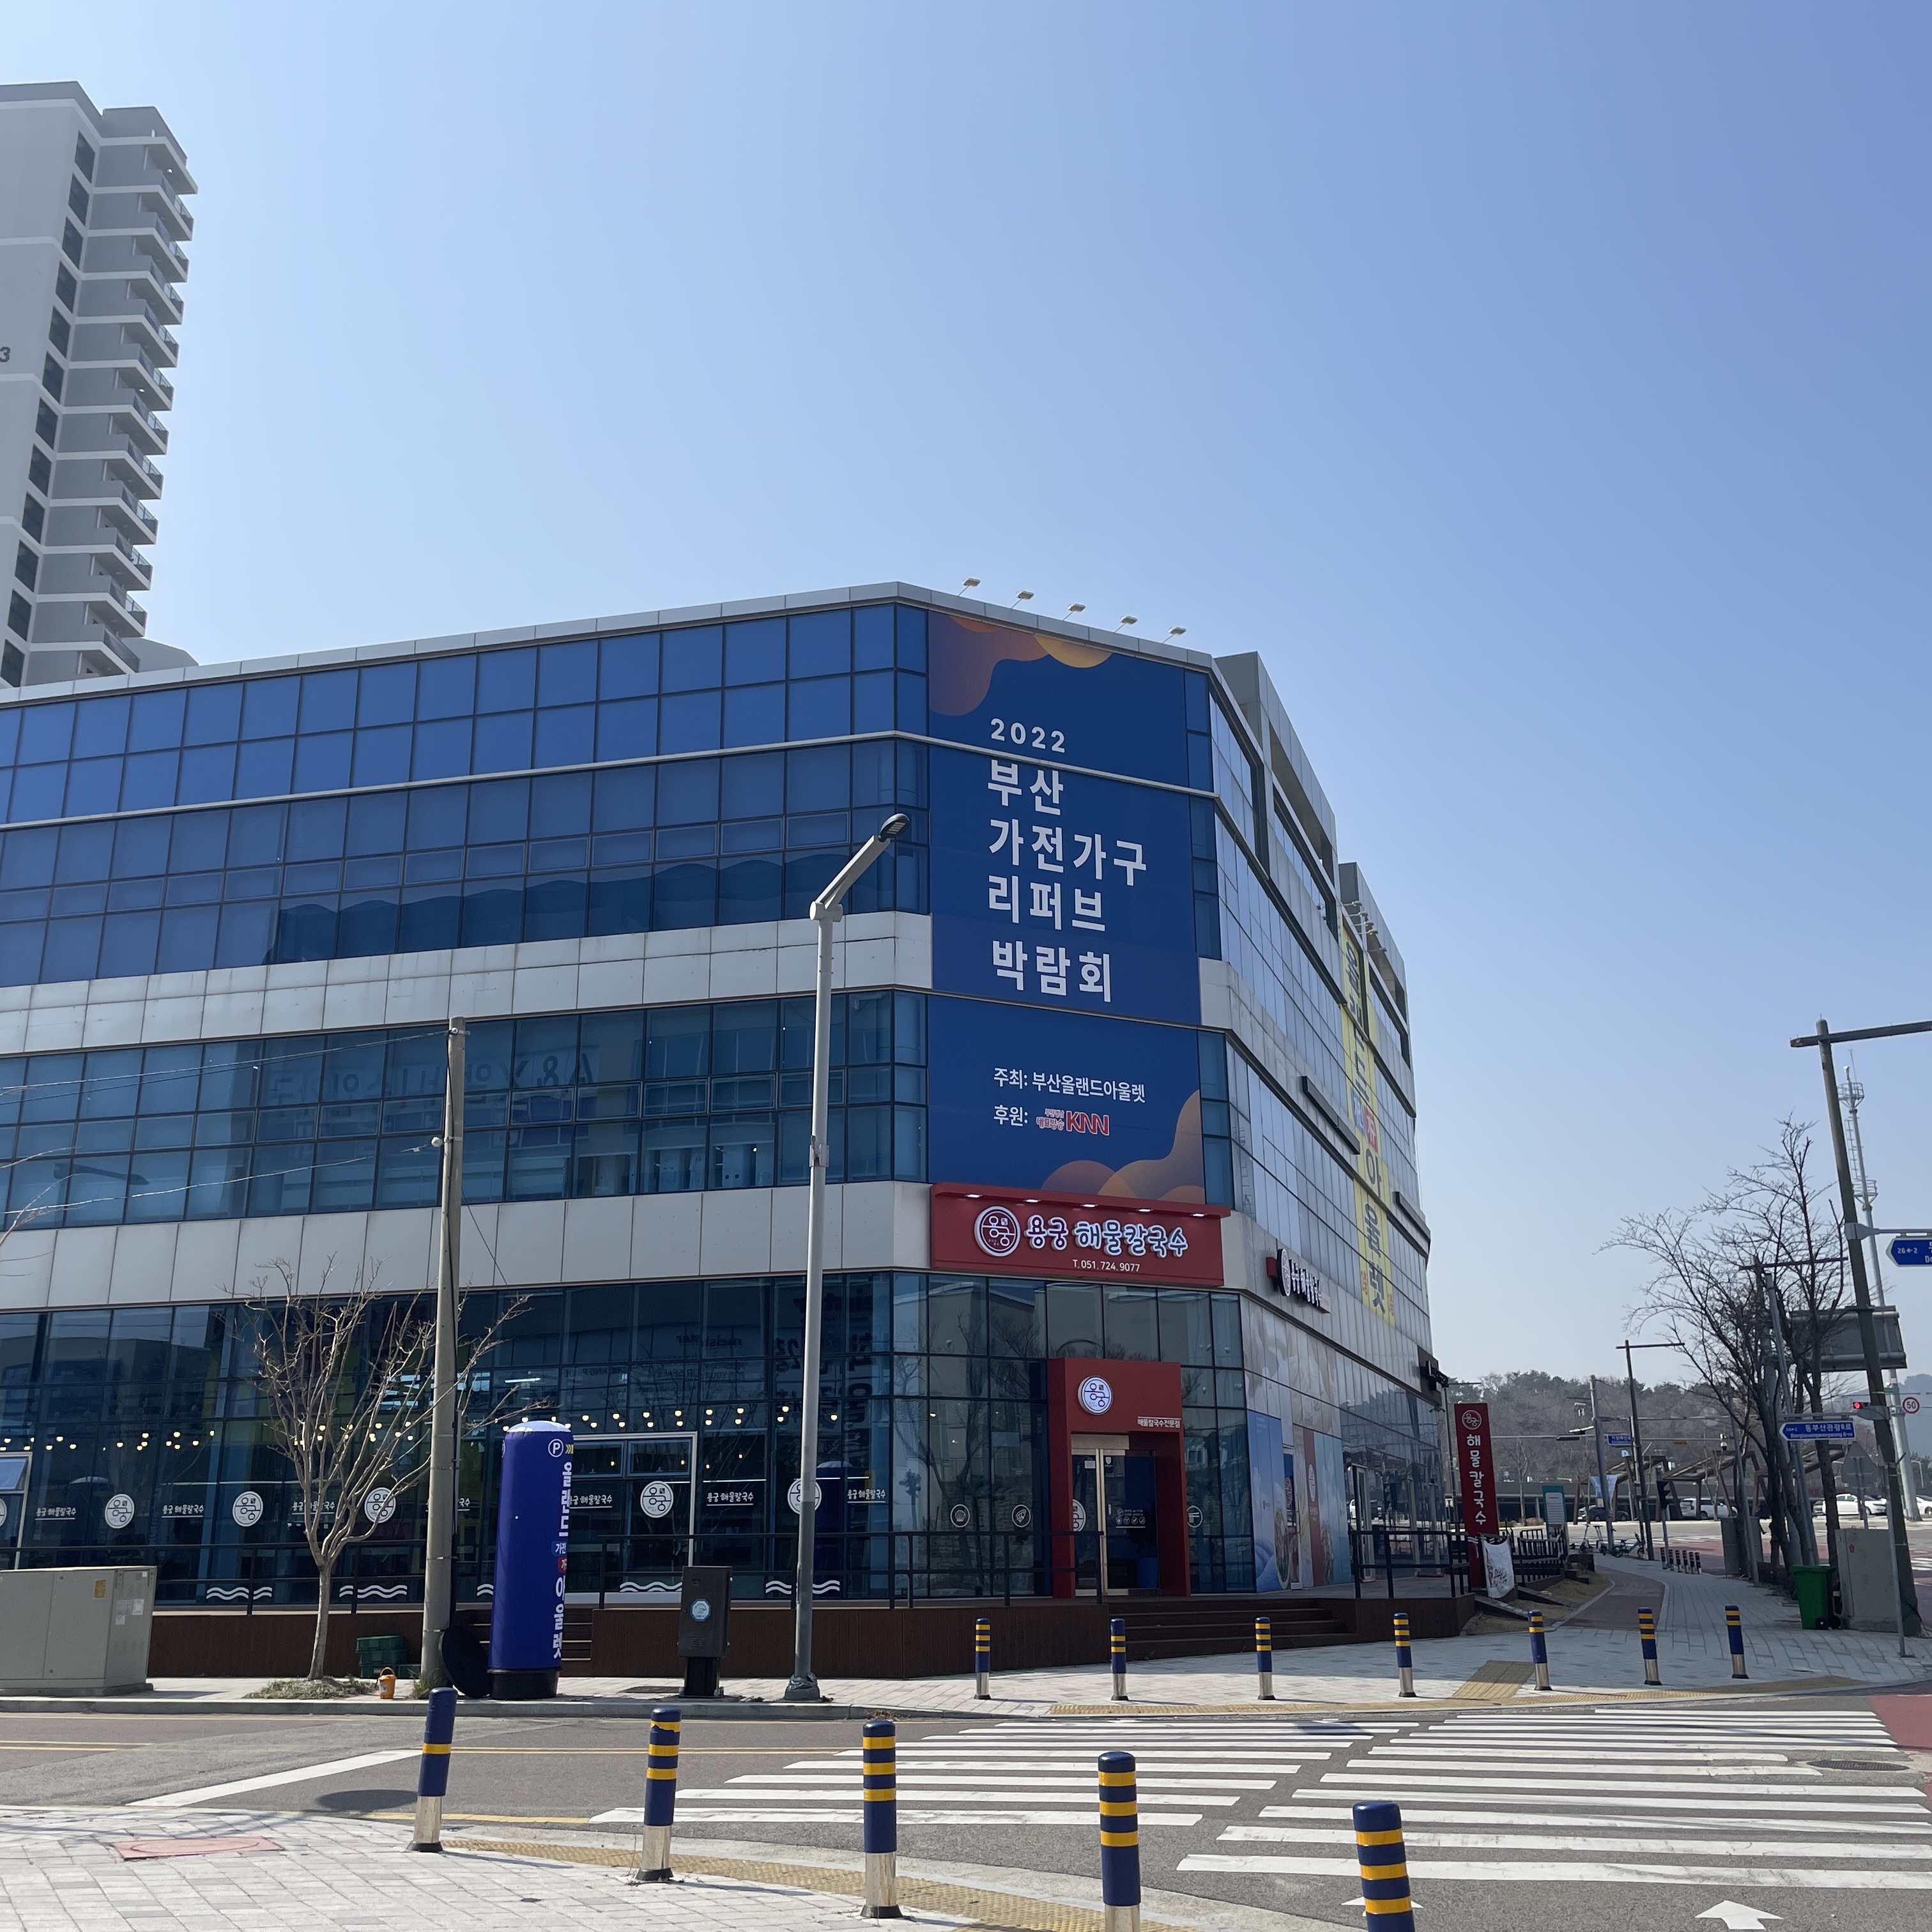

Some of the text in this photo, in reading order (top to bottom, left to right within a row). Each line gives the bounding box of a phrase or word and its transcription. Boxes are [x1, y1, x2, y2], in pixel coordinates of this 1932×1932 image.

[991, 717, 1065, 753] 2022
[988, 759, 1064, 815] 부산
[989, 875, 1105, 931] 리퍼브
[993, 940, 1111, 1002] 박람회
[994, 1068, 1146, 1103] 주최: 부산올랜드아울렛
[994, 1105, 1028, 1126] 후원:
[1066, 1110, 1109, 1135] KNN
[1024, 1215, 1188, 1257] 용궁 해물칼국수
[721, 1491, 754, 1502] 해물칼국수
[1467, 1434, 1487, 1525] 해물칼국수
